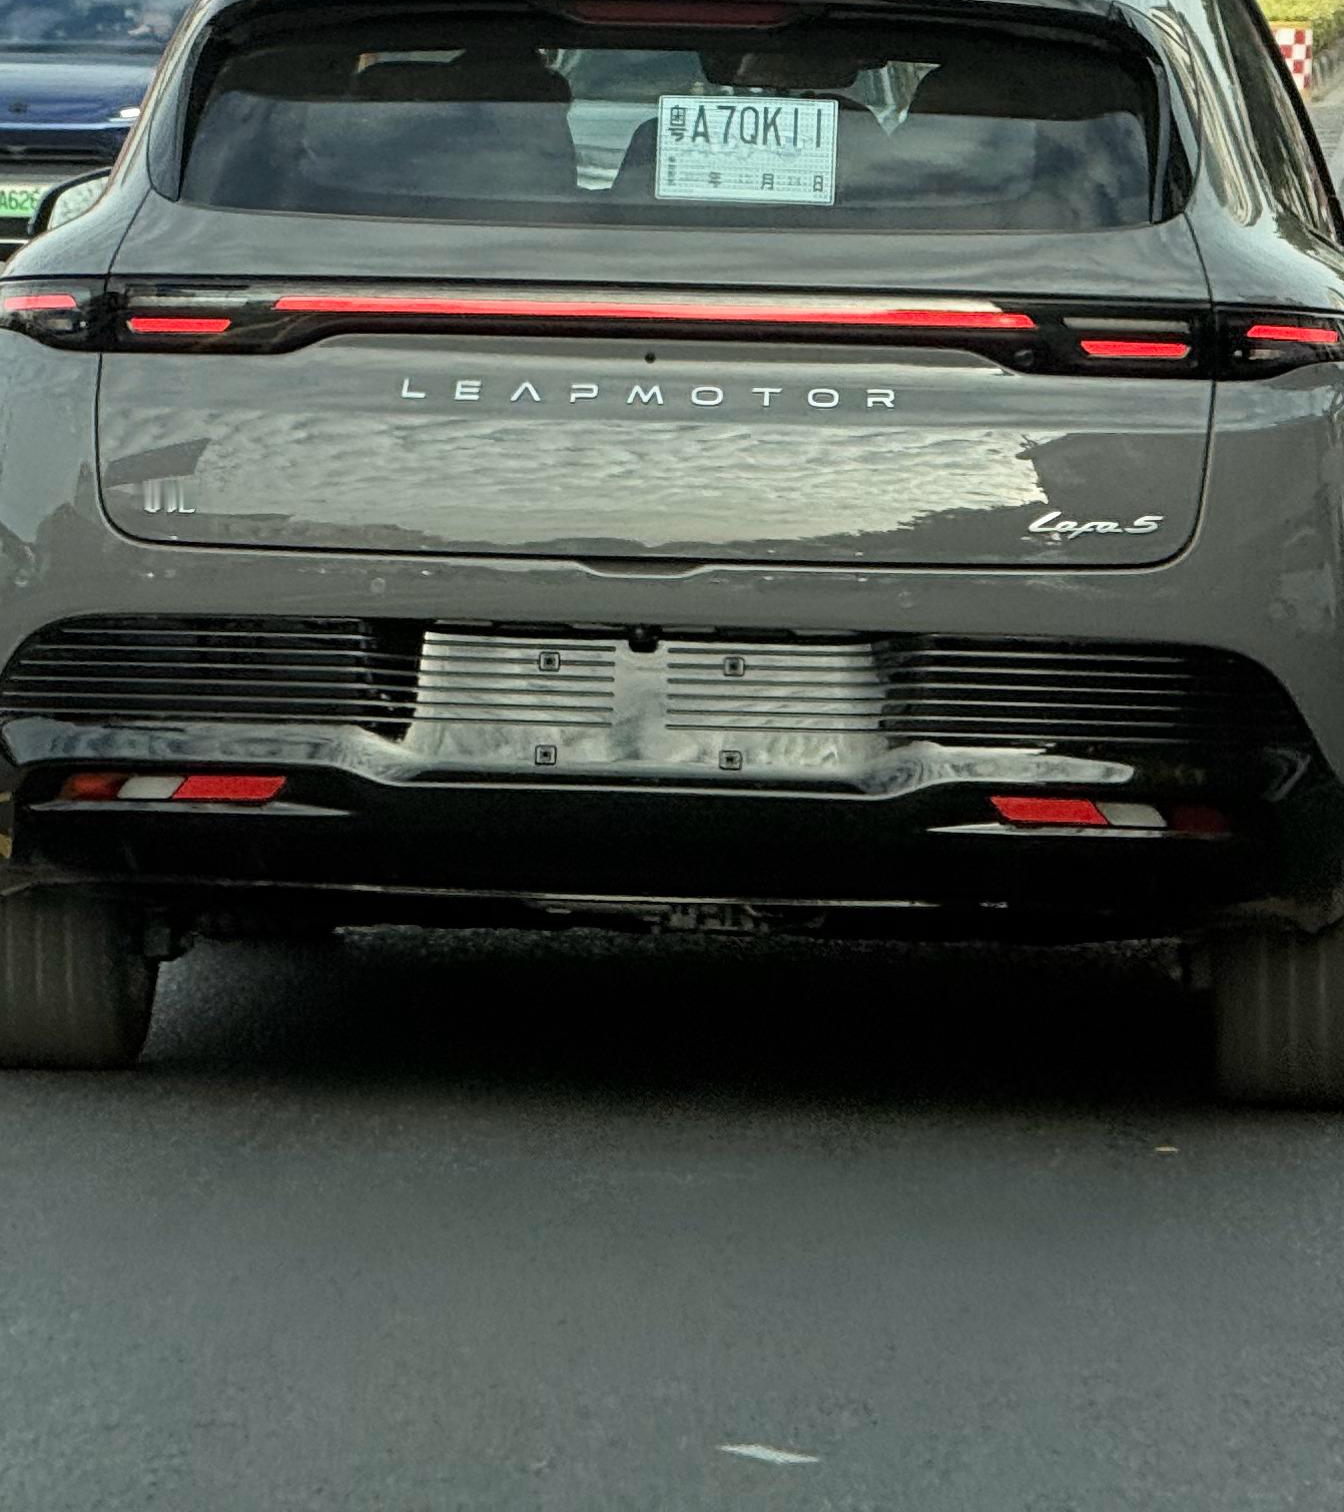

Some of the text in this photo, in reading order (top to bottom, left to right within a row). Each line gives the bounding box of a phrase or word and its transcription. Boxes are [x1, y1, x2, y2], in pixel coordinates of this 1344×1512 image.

[760, 173, 775, 190] 月
[813, 175, 824, 192] 日
[400, 377, 896, 410] LEAPMOTOR
